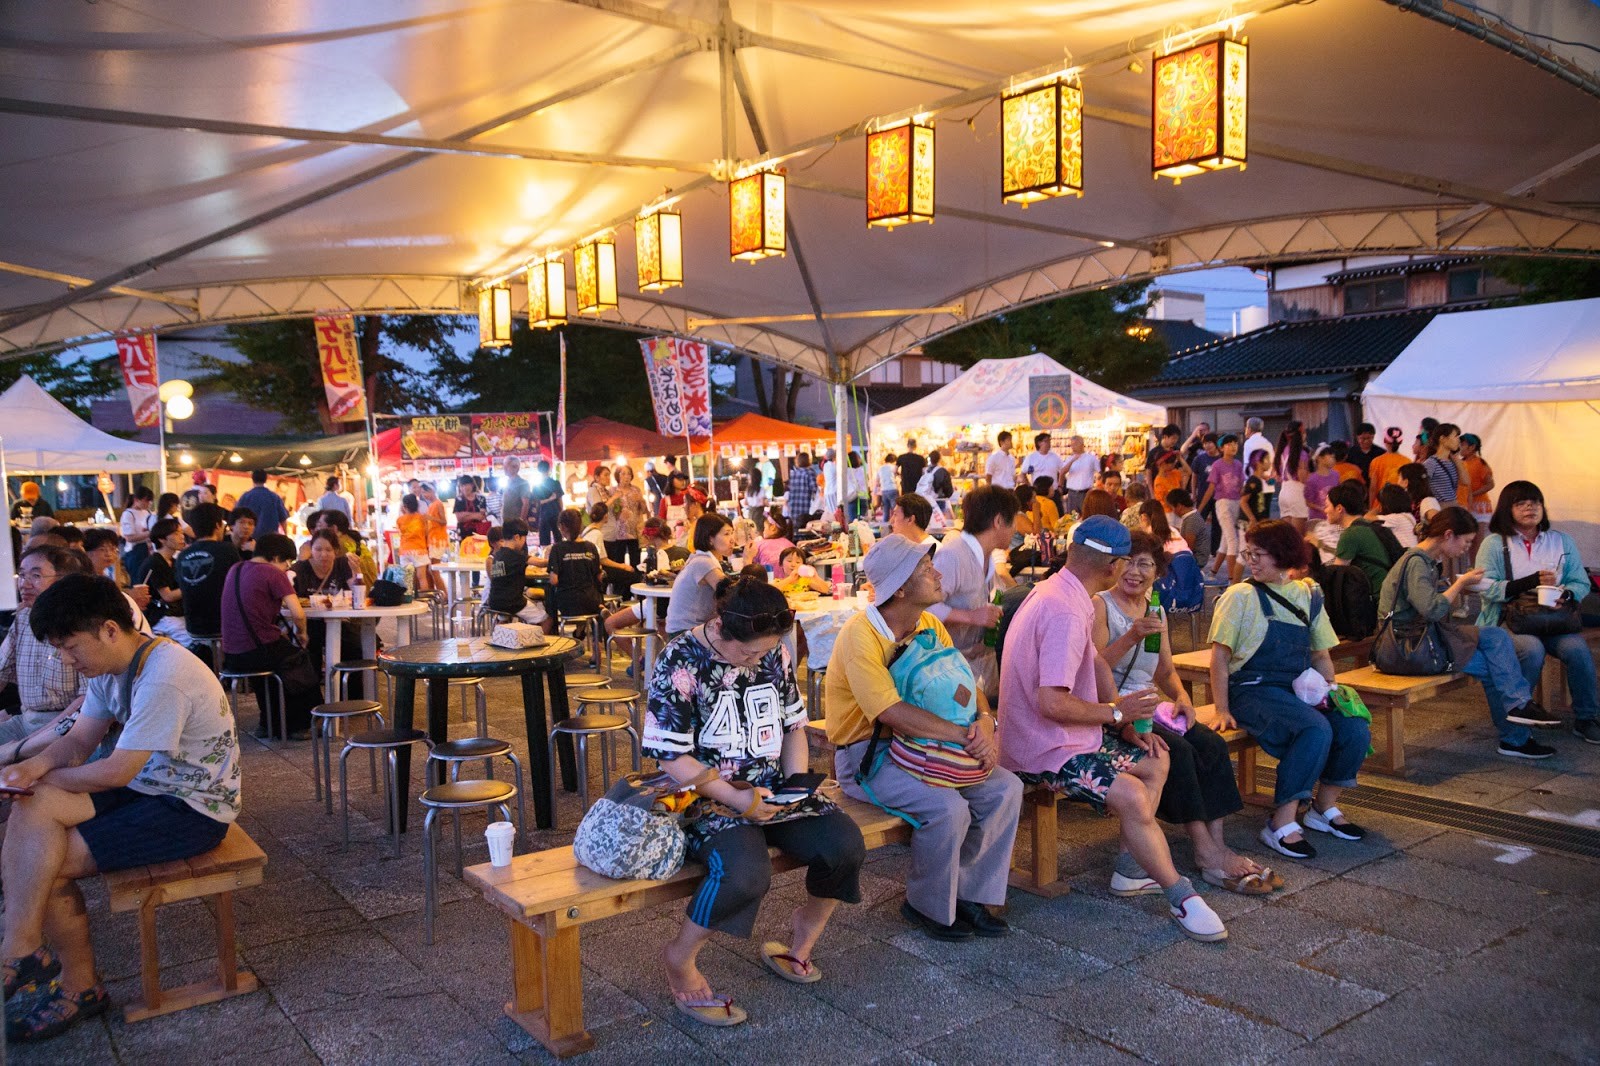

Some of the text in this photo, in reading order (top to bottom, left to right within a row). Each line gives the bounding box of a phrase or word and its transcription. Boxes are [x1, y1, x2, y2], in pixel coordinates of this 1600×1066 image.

[413, 417, 459, 431] 五平餅
[481, 415, 529, 429] オムそば
[699, 683, 784, 759] 48
